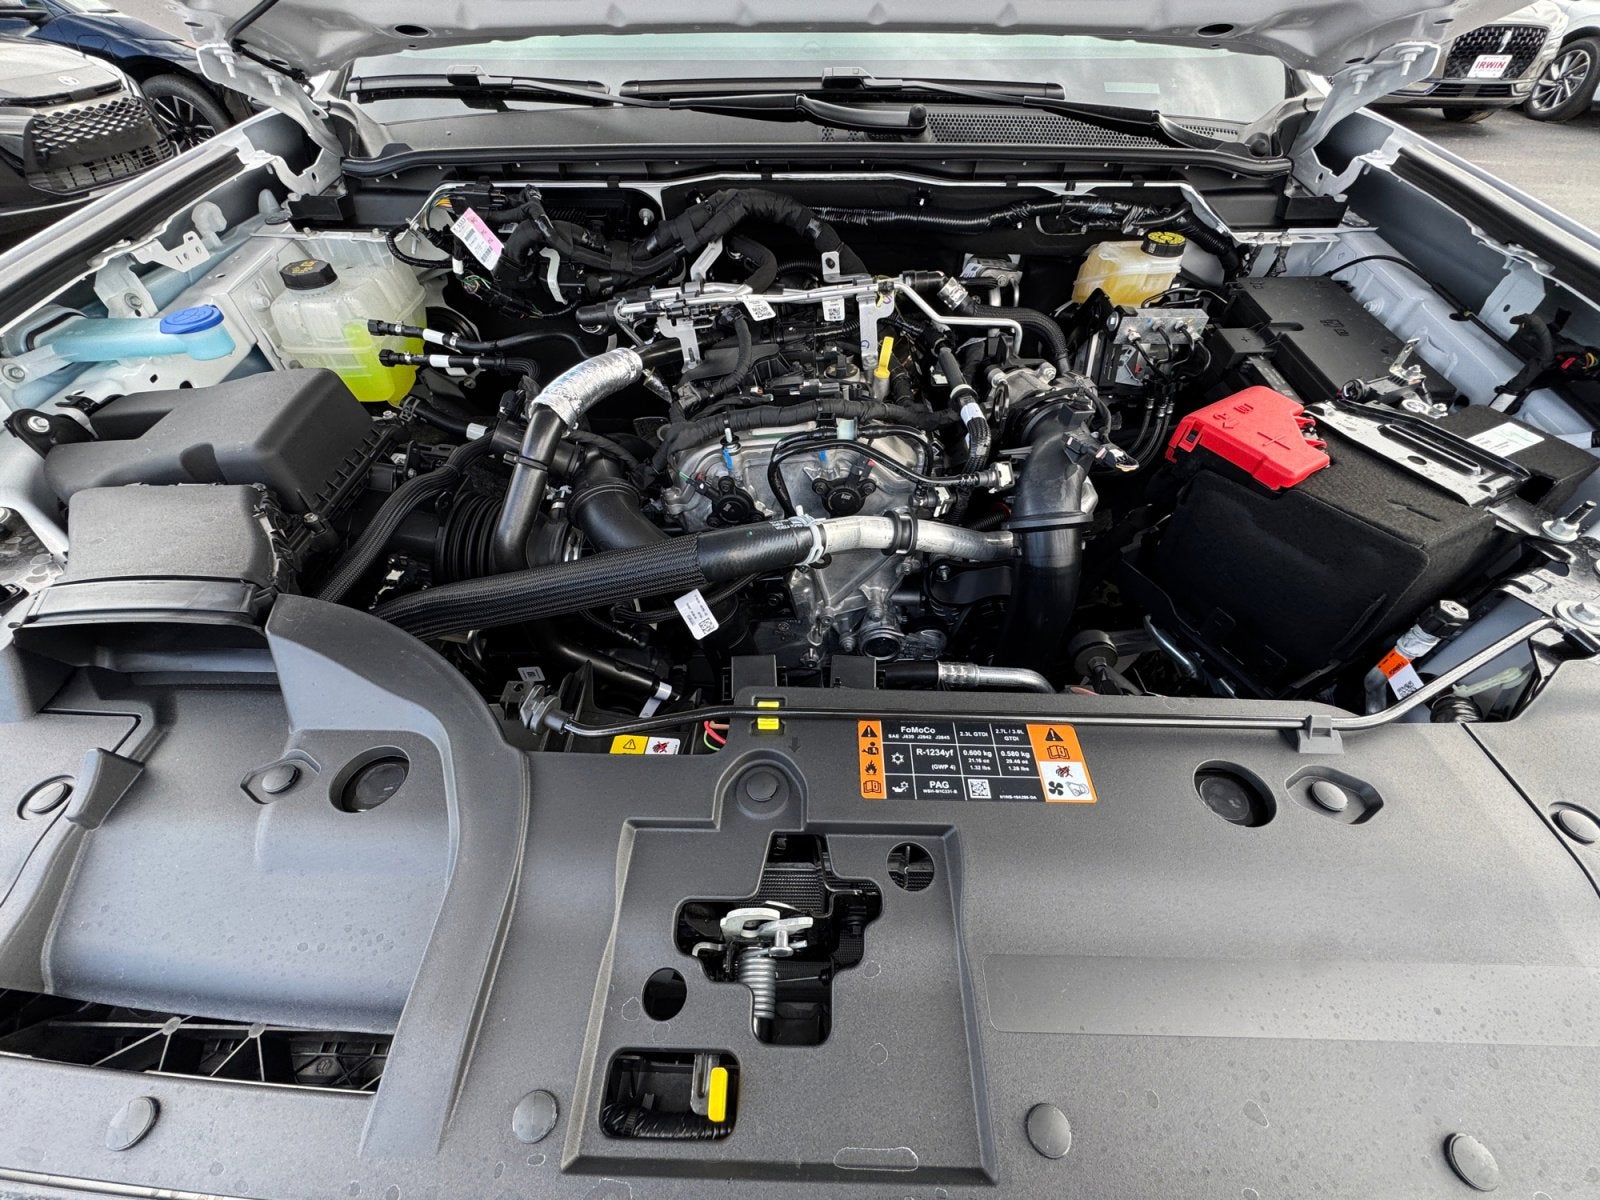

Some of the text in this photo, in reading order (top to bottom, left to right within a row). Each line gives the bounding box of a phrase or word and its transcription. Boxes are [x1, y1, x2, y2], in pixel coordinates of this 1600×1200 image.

[1475, 61, 1506, 69] IRWIN
[900, 726, 936, 734] FoMoCo
[916, 748, 954, 757] R-1234yf
